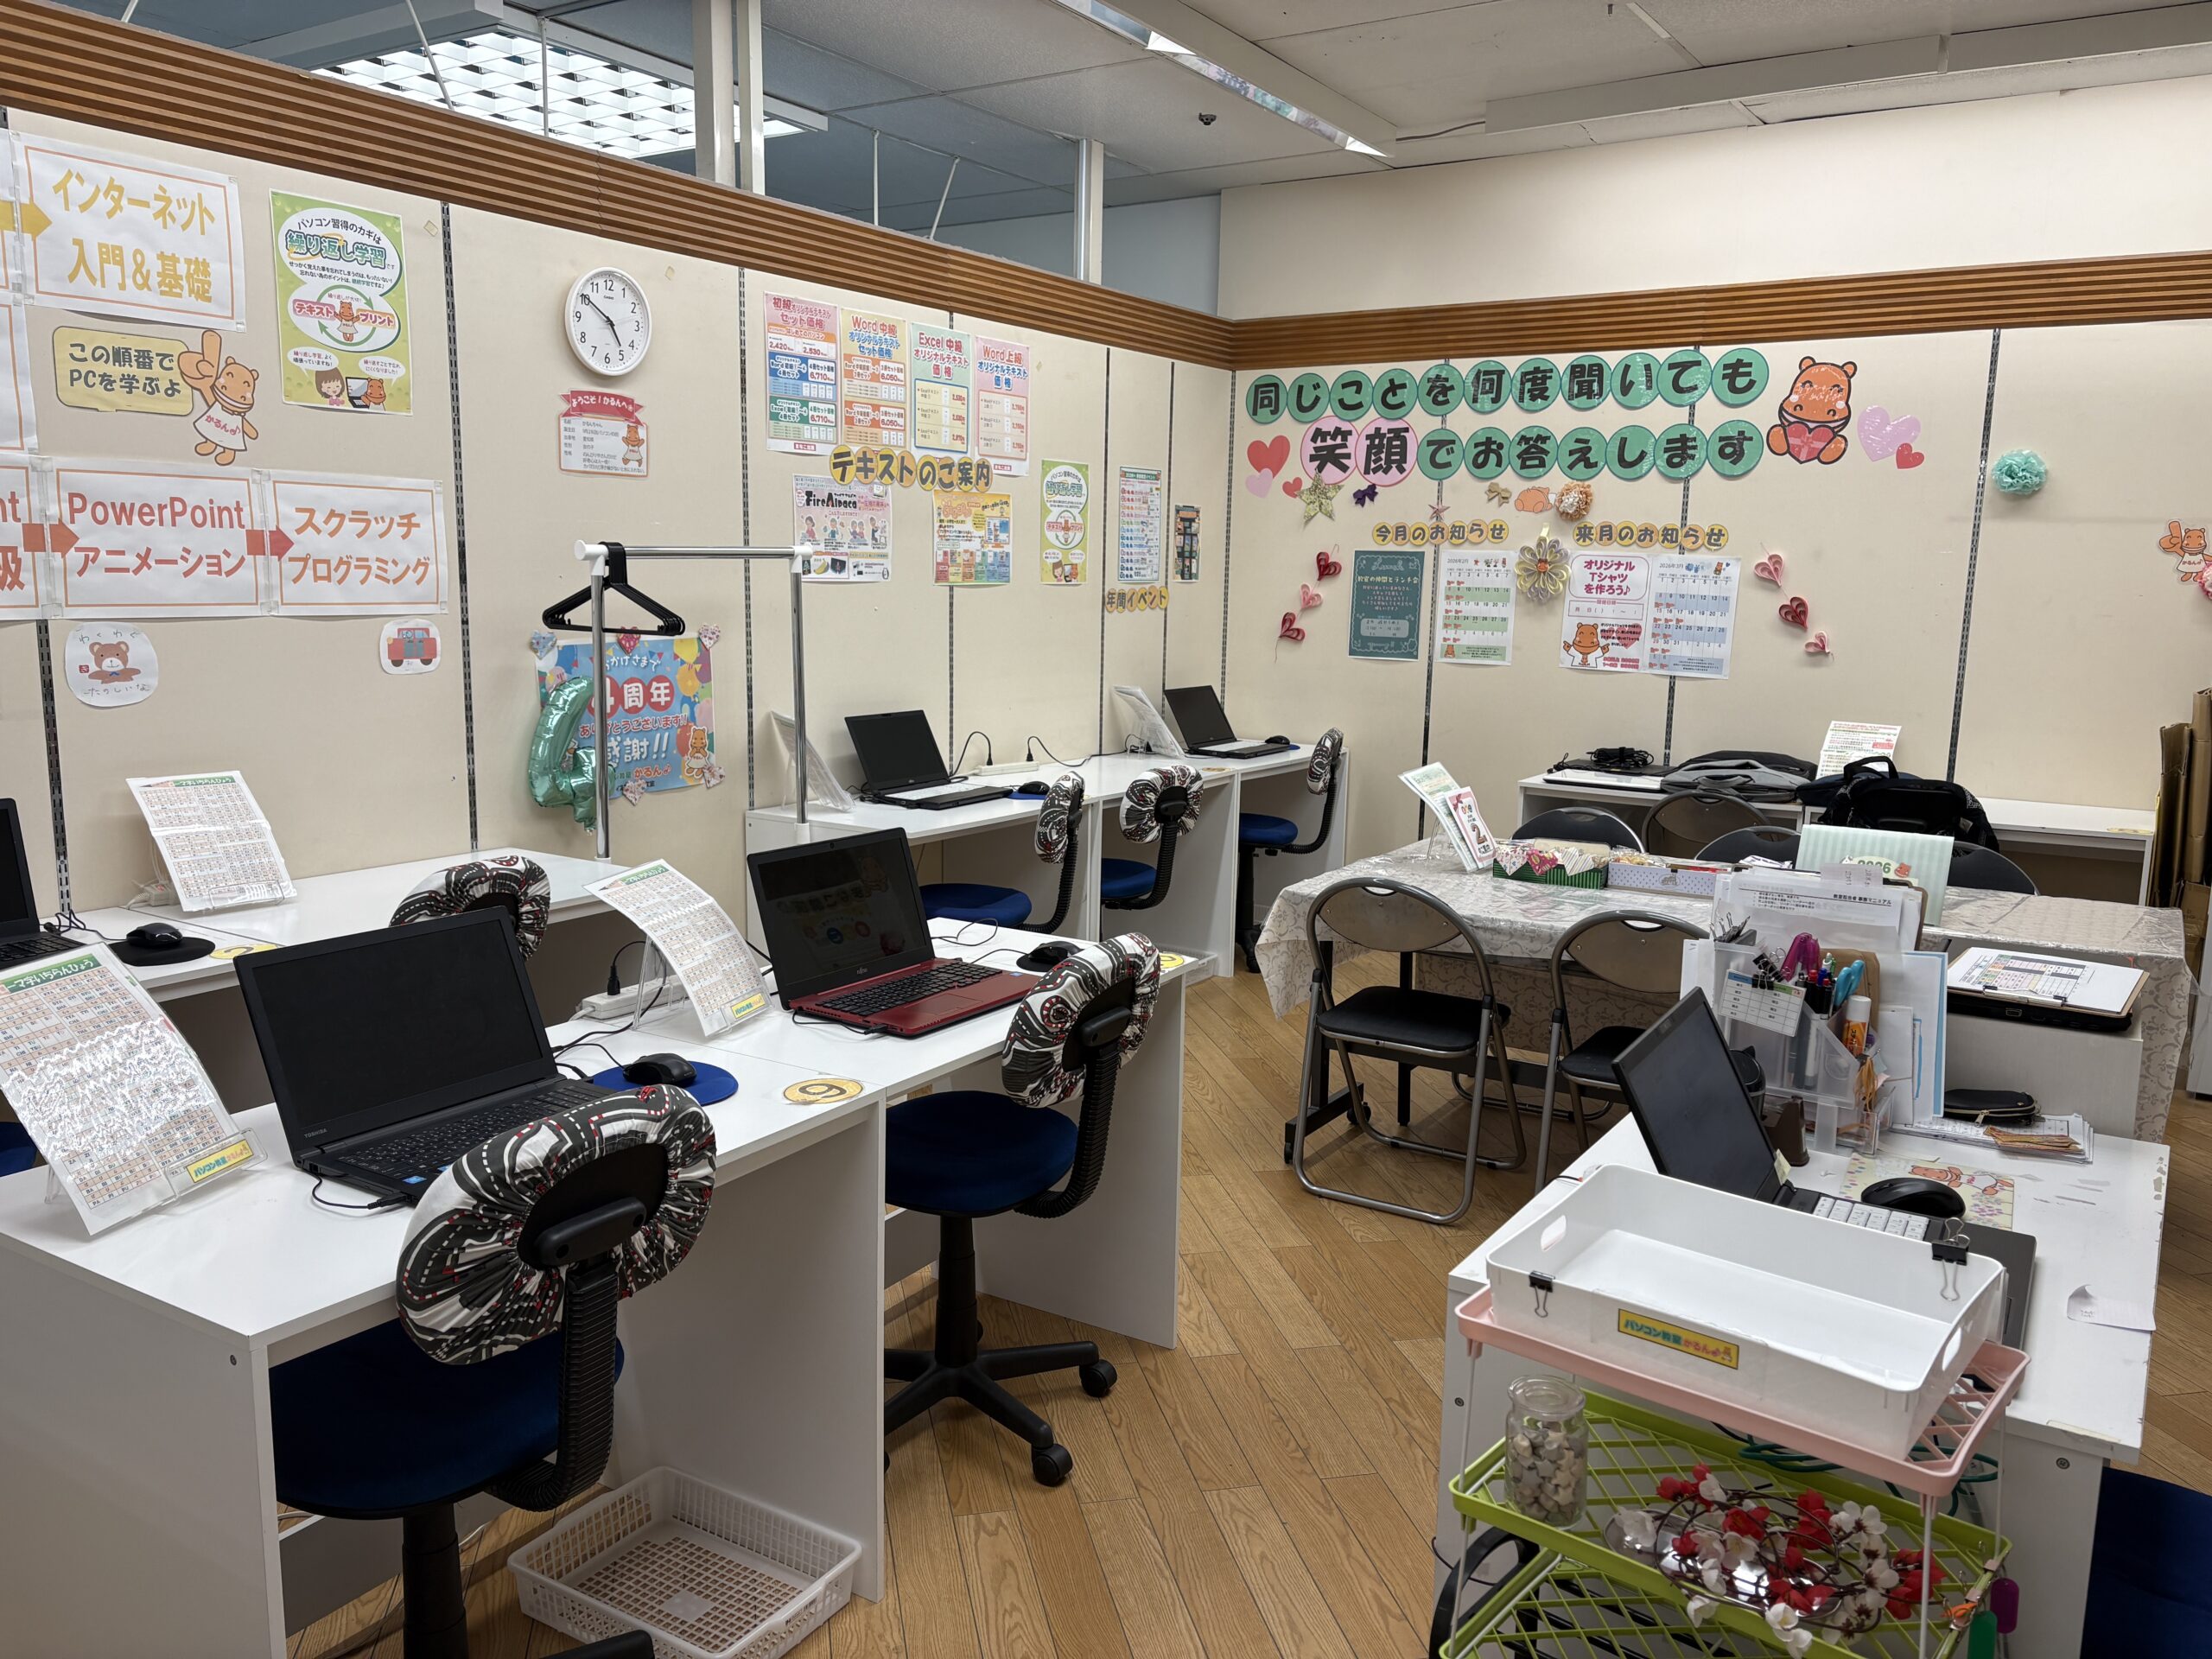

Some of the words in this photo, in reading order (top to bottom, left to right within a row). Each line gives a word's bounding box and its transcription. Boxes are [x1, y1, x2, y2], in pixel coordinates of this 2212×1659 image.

[53, 168, 216, 236] インターネット
[297, 217, 382, 245] パソコン習得のカギは
[286, 230, 386, 269] 繰り返し学習
[590, 281, 599, 294] 11
[604, 279, 613, 292] 12
[621, 287, 626, 298] 1
[580, 294, 590, 306] 10
[631, 302, 637, 314] 2
[295, 302, 334, 318] テキスト
[359, 310, 394, 327] プリント
[575, 311, 582, 322] 9
[634, 321, 640, 333] 3
[780, 312, 824, 330] セット価格
[852, 315, 877, 333] Word
[580, 332, 586, 343] 8
[628, 340, 635, 350] 4
[919, 332, 944, 348] Excel
[69, 342, 174, 372] この順番で
[591, 346, 597, 357] 7
[605, 353, 610, 364] 6
[619, 350, 625, 361] 5
[858, 344, 893, 358] セット価格
[914, 348, 969, 365] オリジナルテキスト
[983, 346, 1005, 361] Word
[1006, 350, 1022, 364] 上級
[978, 360, 1027, 378] オリジナルテキスト
[69, 369, 181, 397] PCを学ぶよ
[1253, 358, 1757, 416] 同じことを何度聞いても
[1309, 426, 1753, 476] 笑顔でお答えします
[833, 450, 989, 489] テキストのご案内
[68, 492, 245, 529] PowerPoint
[295, 505, 421, 541] スクラッチ
[1376, 524, 1505, 543] 今月のお知らせ
[1576, 524, 1725, 547] 来月のお知らせ
[74, 546, 245, 580] アニメーション
[287, 556, 430, 586] プログラミング
[1584, 560, 1635, 571] オリジナル
[1589, 572, 1628, 583] Tシャツ
[1584, 583, 1624, 595] を作ろう
[1107, 590, 1166, 609] 年間イベント
[798, 1084, 847, 1099] 9
[303, 1128, 327, 1140] TOSHIBA
